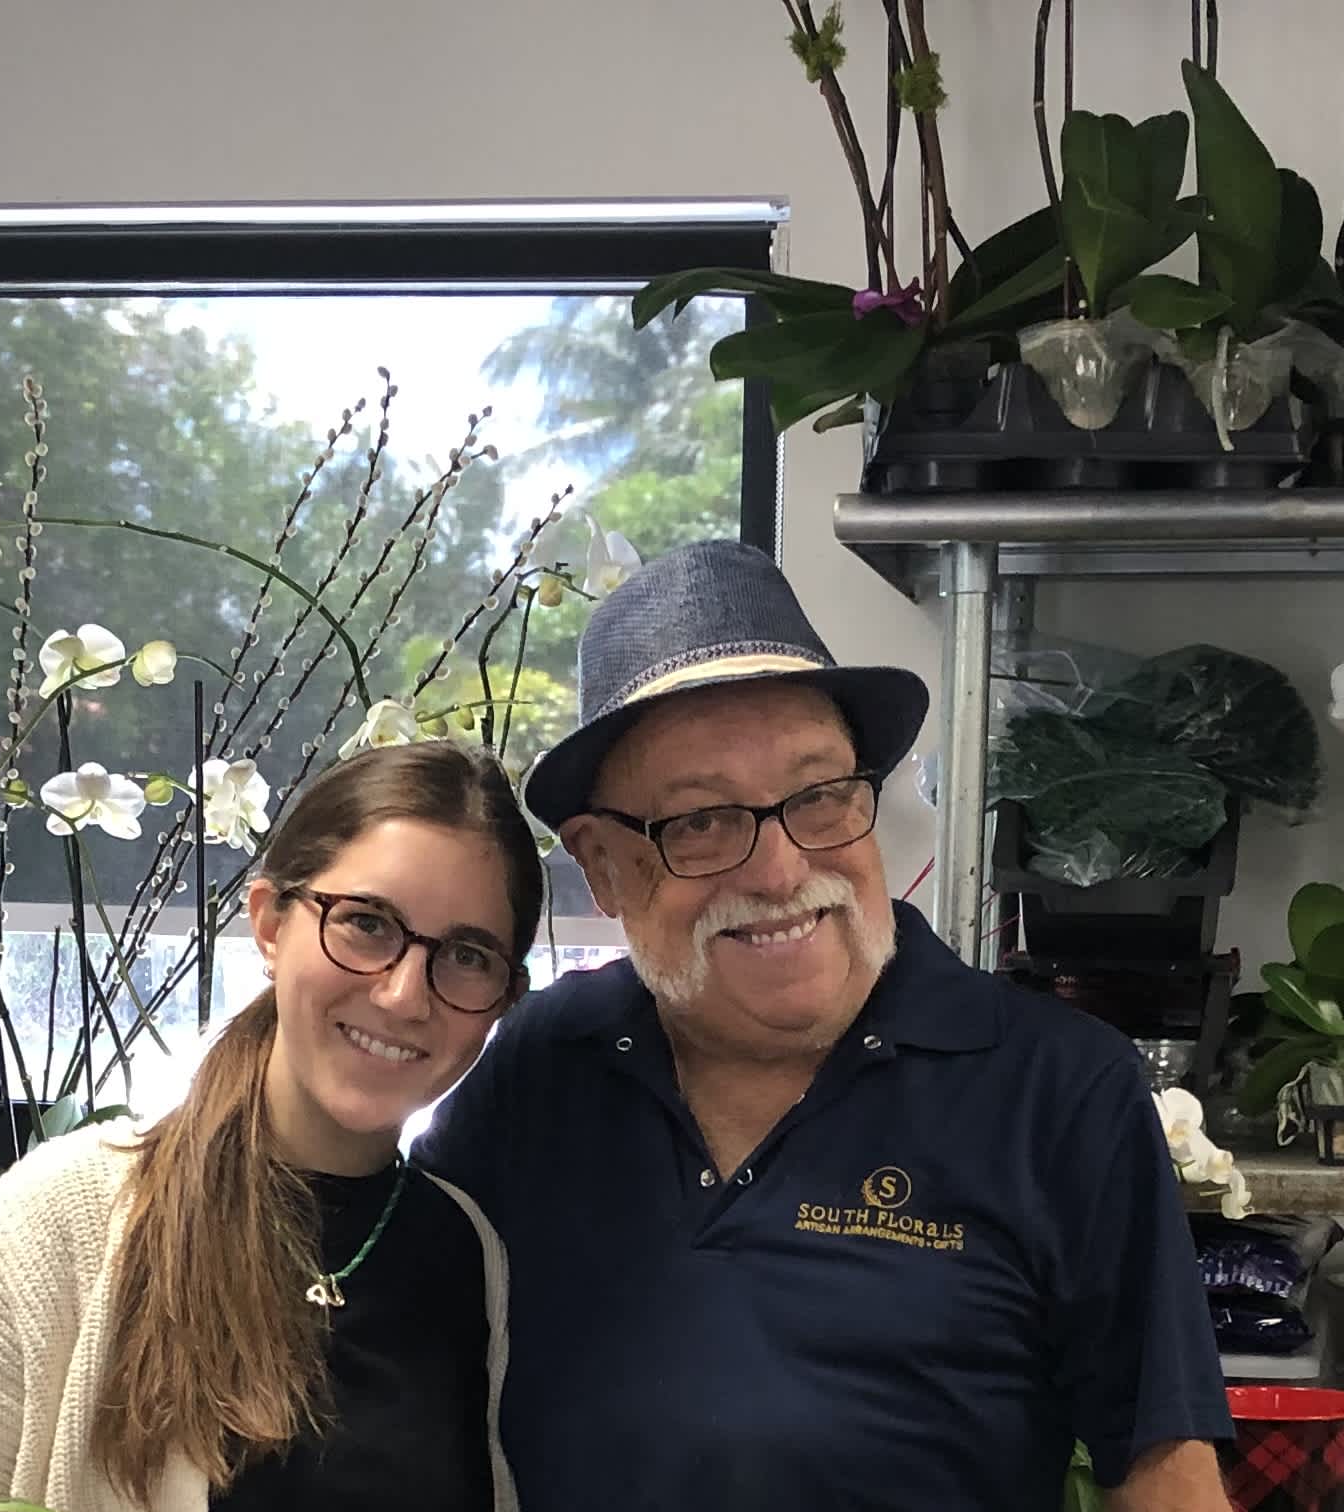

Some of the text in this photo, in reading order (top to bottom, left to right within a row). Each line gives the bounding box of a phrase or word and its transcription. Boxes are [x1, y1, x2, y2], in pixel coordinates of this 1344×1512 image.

[879, 1176, 897, 1198] S
[797, 1203, 869, 1225] SOUTH
[794, 1220, 841, 1235] ARTISAN
